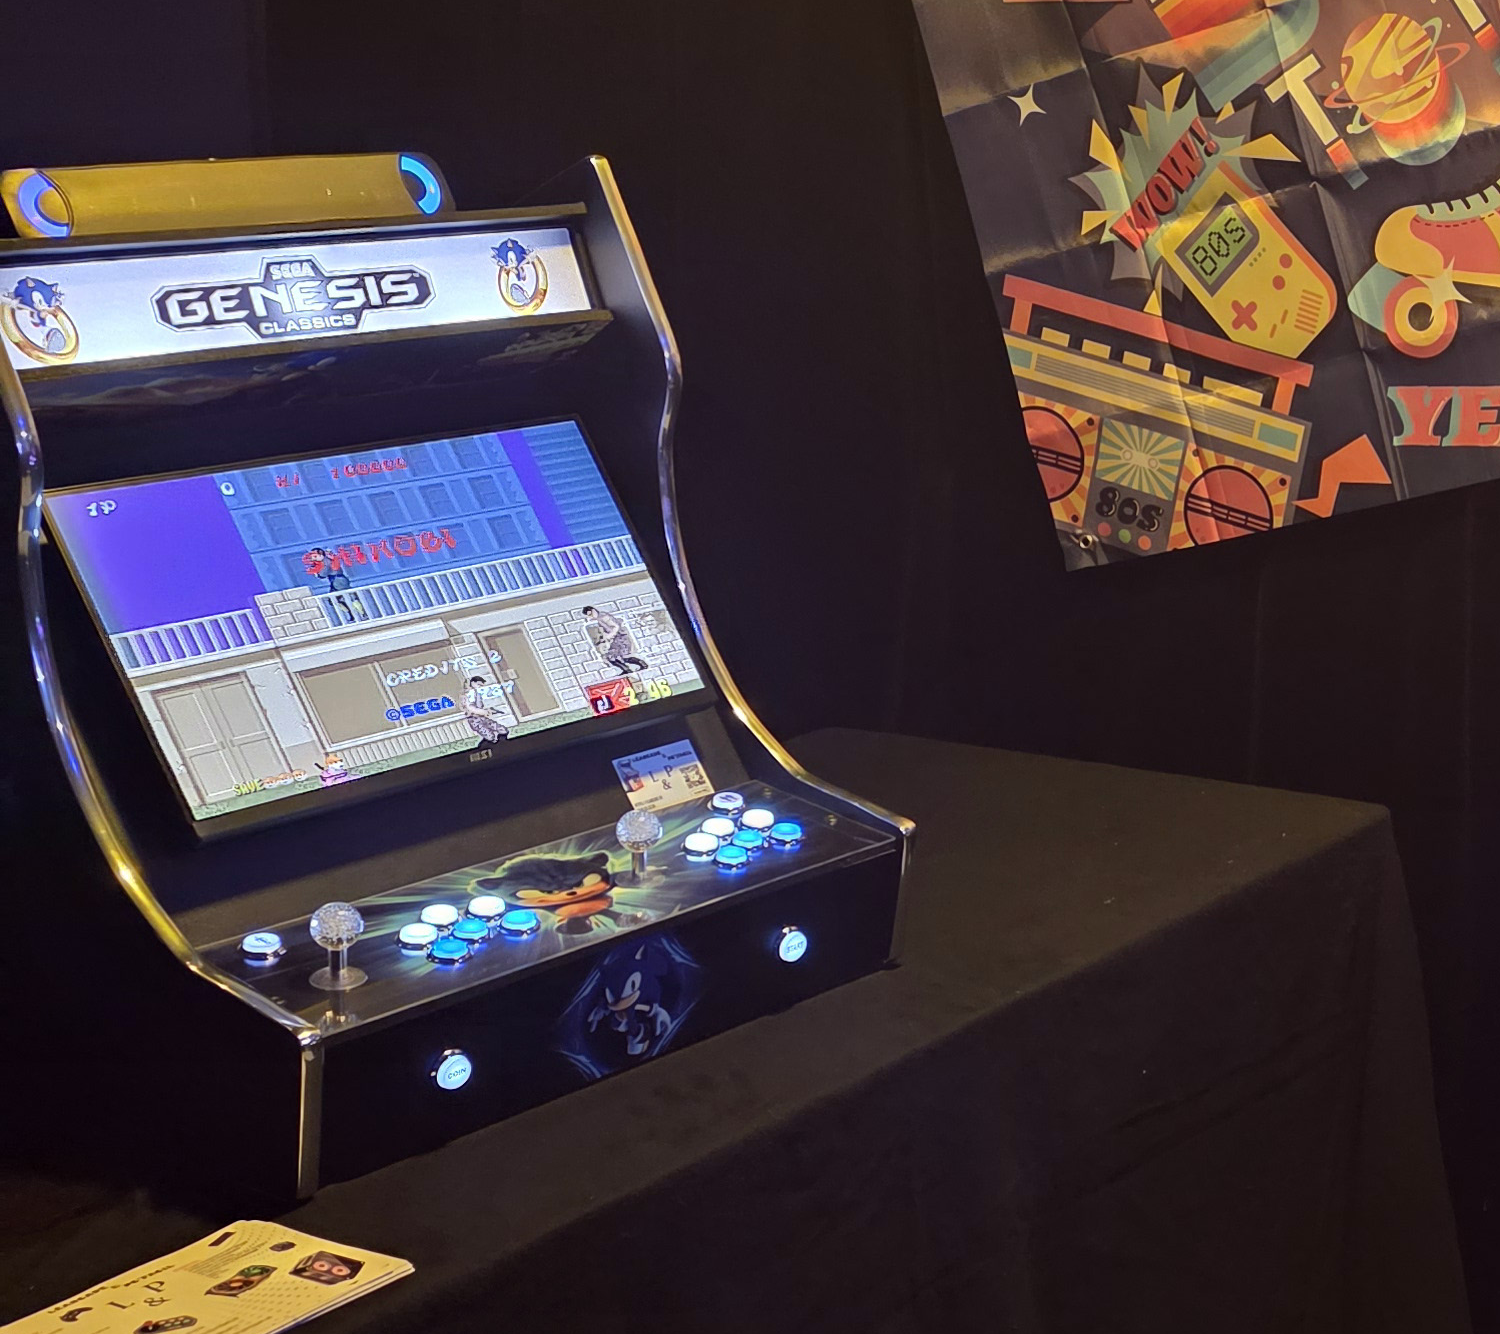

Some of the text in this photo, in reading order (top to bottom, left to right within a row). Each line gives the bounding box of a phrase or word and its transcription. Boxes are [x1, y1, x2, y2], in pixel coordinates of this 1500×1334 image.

[1110, 116, 1219, 251] WOW!
[270, 262, 316, 280] SEGA
[165, 272, 420, 325] GENESIS
[259, 313, 356, 336] CLASSICS
[447, 1067, 468, 1080] COIN
